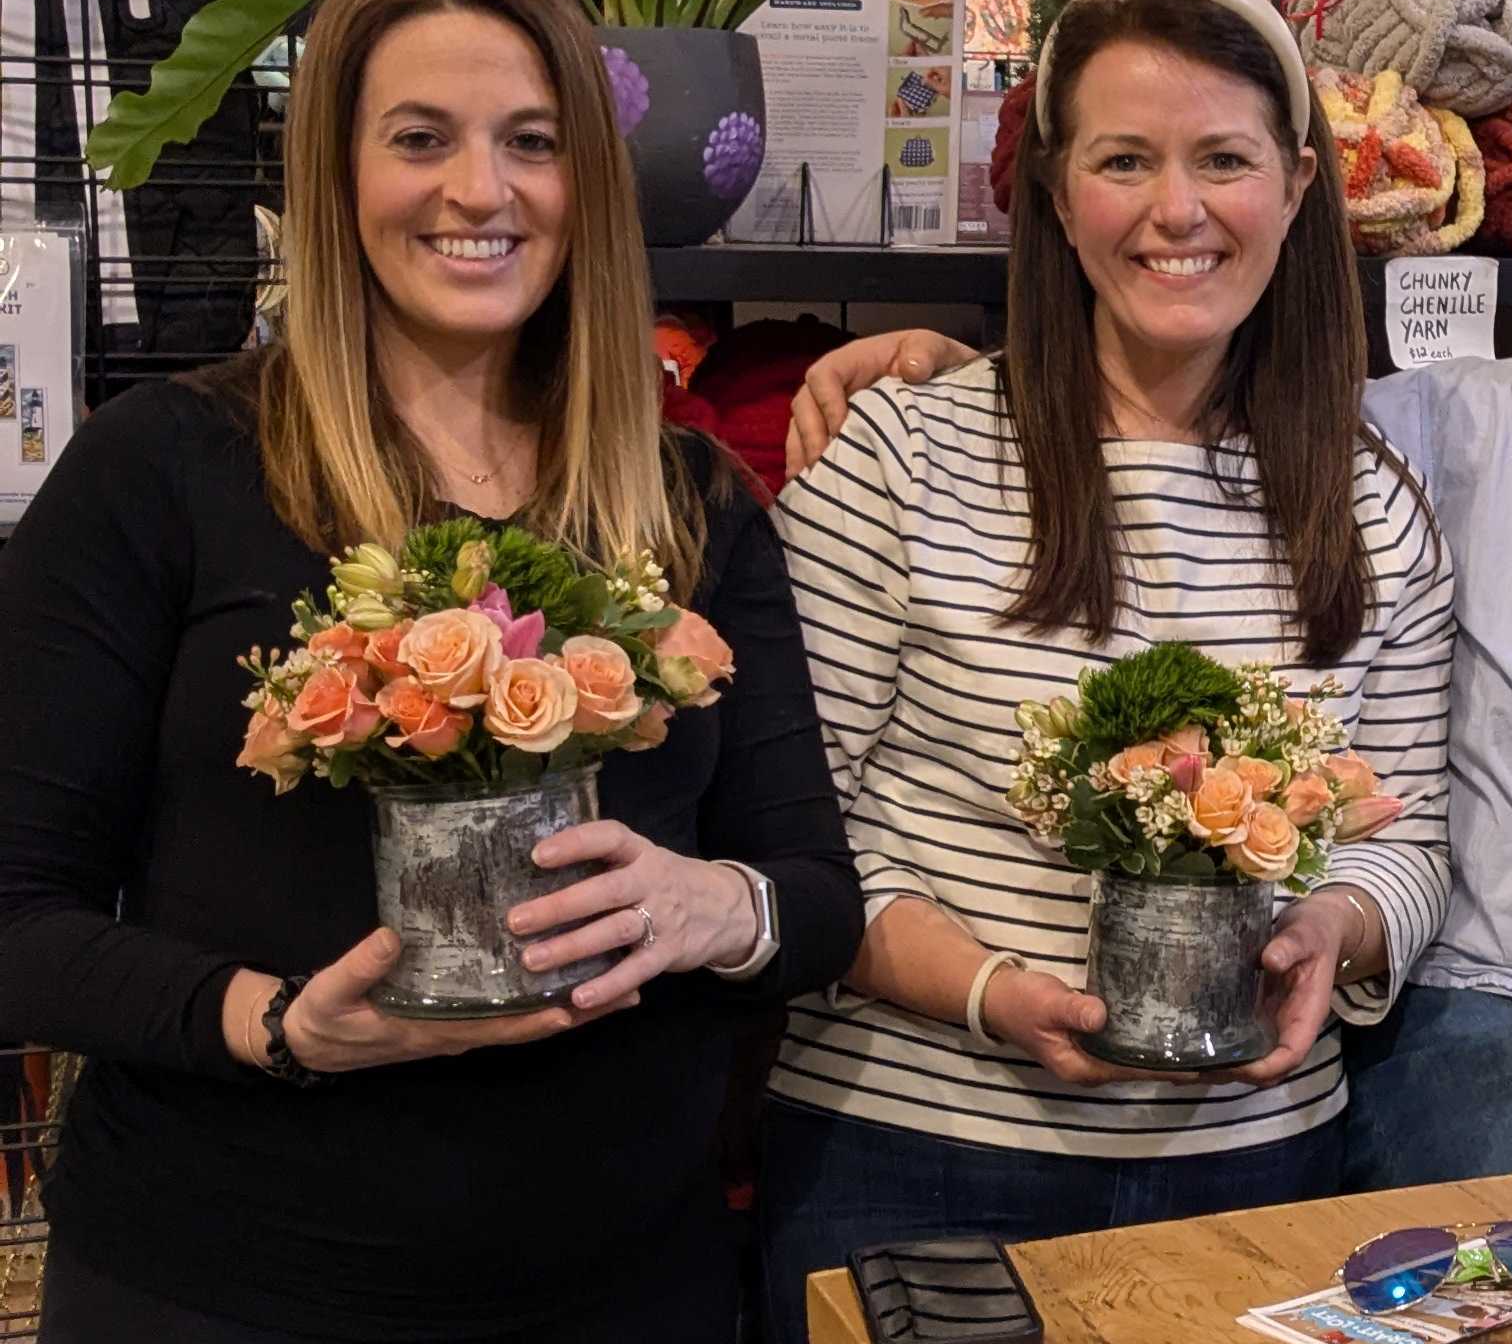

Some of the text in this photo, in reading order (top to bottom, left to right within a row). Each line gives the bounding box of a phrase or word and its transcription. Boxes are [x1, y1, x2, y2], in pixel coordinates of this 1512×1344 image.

[1400, 271, 1473, 292] CHUNKY
[1400, 293, 1486, 315] CHENILLE
[1401, 318, 1448, 344] YARN
[1409, 346, 1453, 359] $12 each
